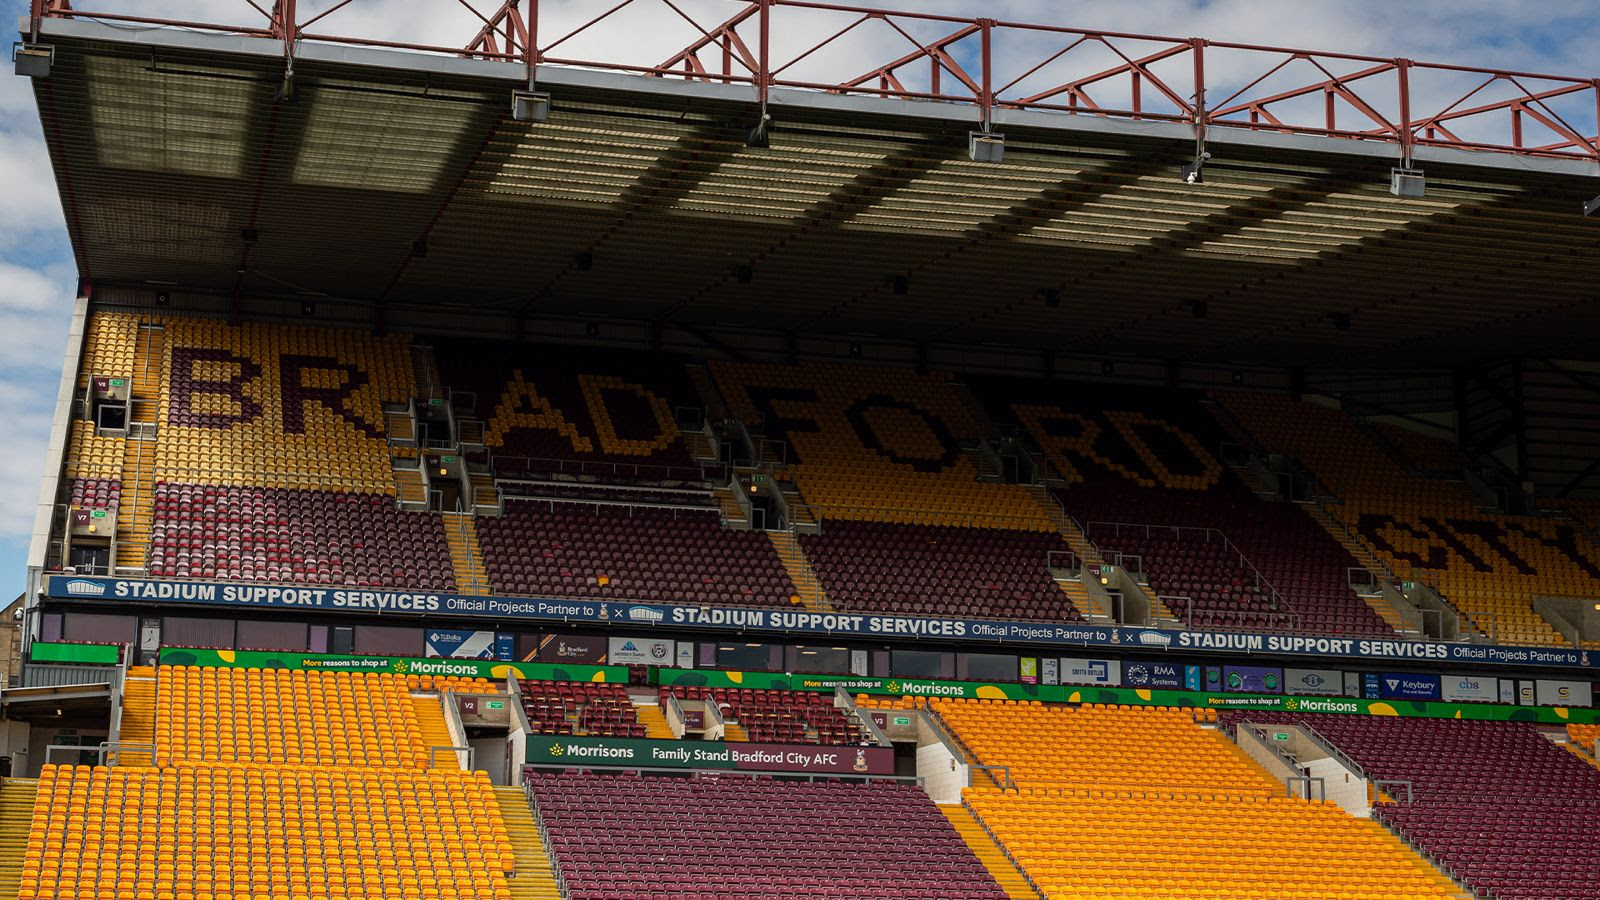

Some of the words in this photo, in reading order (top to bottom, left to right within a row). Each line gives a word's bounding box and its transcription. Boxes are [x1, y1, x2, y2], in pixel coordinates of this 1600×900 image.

[114, 581, 216, 601] STADIUM
[222, 586, 327, 606] SUPPORT
[333, 590, 440, 611] SERVICES
[446, 597, 486, 612] Official
[489, 600, 535, 616] Projects
[538, 602, 580, 616] Partner
[582, 606, 594, 616] to
[672, 606, 764, 626] STADIUM
[769, 613, 864, 631] SUPPORT
[869, 616, 966, 636] SERVICES
[972, 624, 1008, 637] Official
[1011, 626, 1053, 641] Projects
[1055, 629, 1094, 642] Partner
[1096, 631, 1107, 642] to
[1178, 631, 1263, 650] STADIUM
[1268, 636, 1354, 654] SUPPORT
[1359, 640, 1448, 659] SERVICES
[1453, 647, 1487, 659] Official
[1489, 649, 1528, 662] Projects
[1530, 651, 1566, 663] Partner
[1568, 653, 1577, 663] to
[302, 659, 321, 667] More
[323, 659, 351, 667] reasons
[361, 659, 379, 669] shop
[380, 659, 388, 667] at
[410, 661, 478, 675] Morrisons
[1154, 666, 1175, 676] RMA
[857, 681, 873, 689] shop
[902, 682, 964, 695] Morrisons
[1152, 678, 1178, 686] Systems
[1403, 680, 1435, 691] Keybury
[1459, 678, 1479, 689] cbs
[1300, 699, 1358, 712] Morrisons
[566, 744, 634, 758] Morrisons
[652, 748, 691, 763] Family
[694, 749, 729, 761] Stand
[732, 751, 783, 763] Bradford
[786, 752, 811, 767] City
[813, 754, 838, 765] AFC
